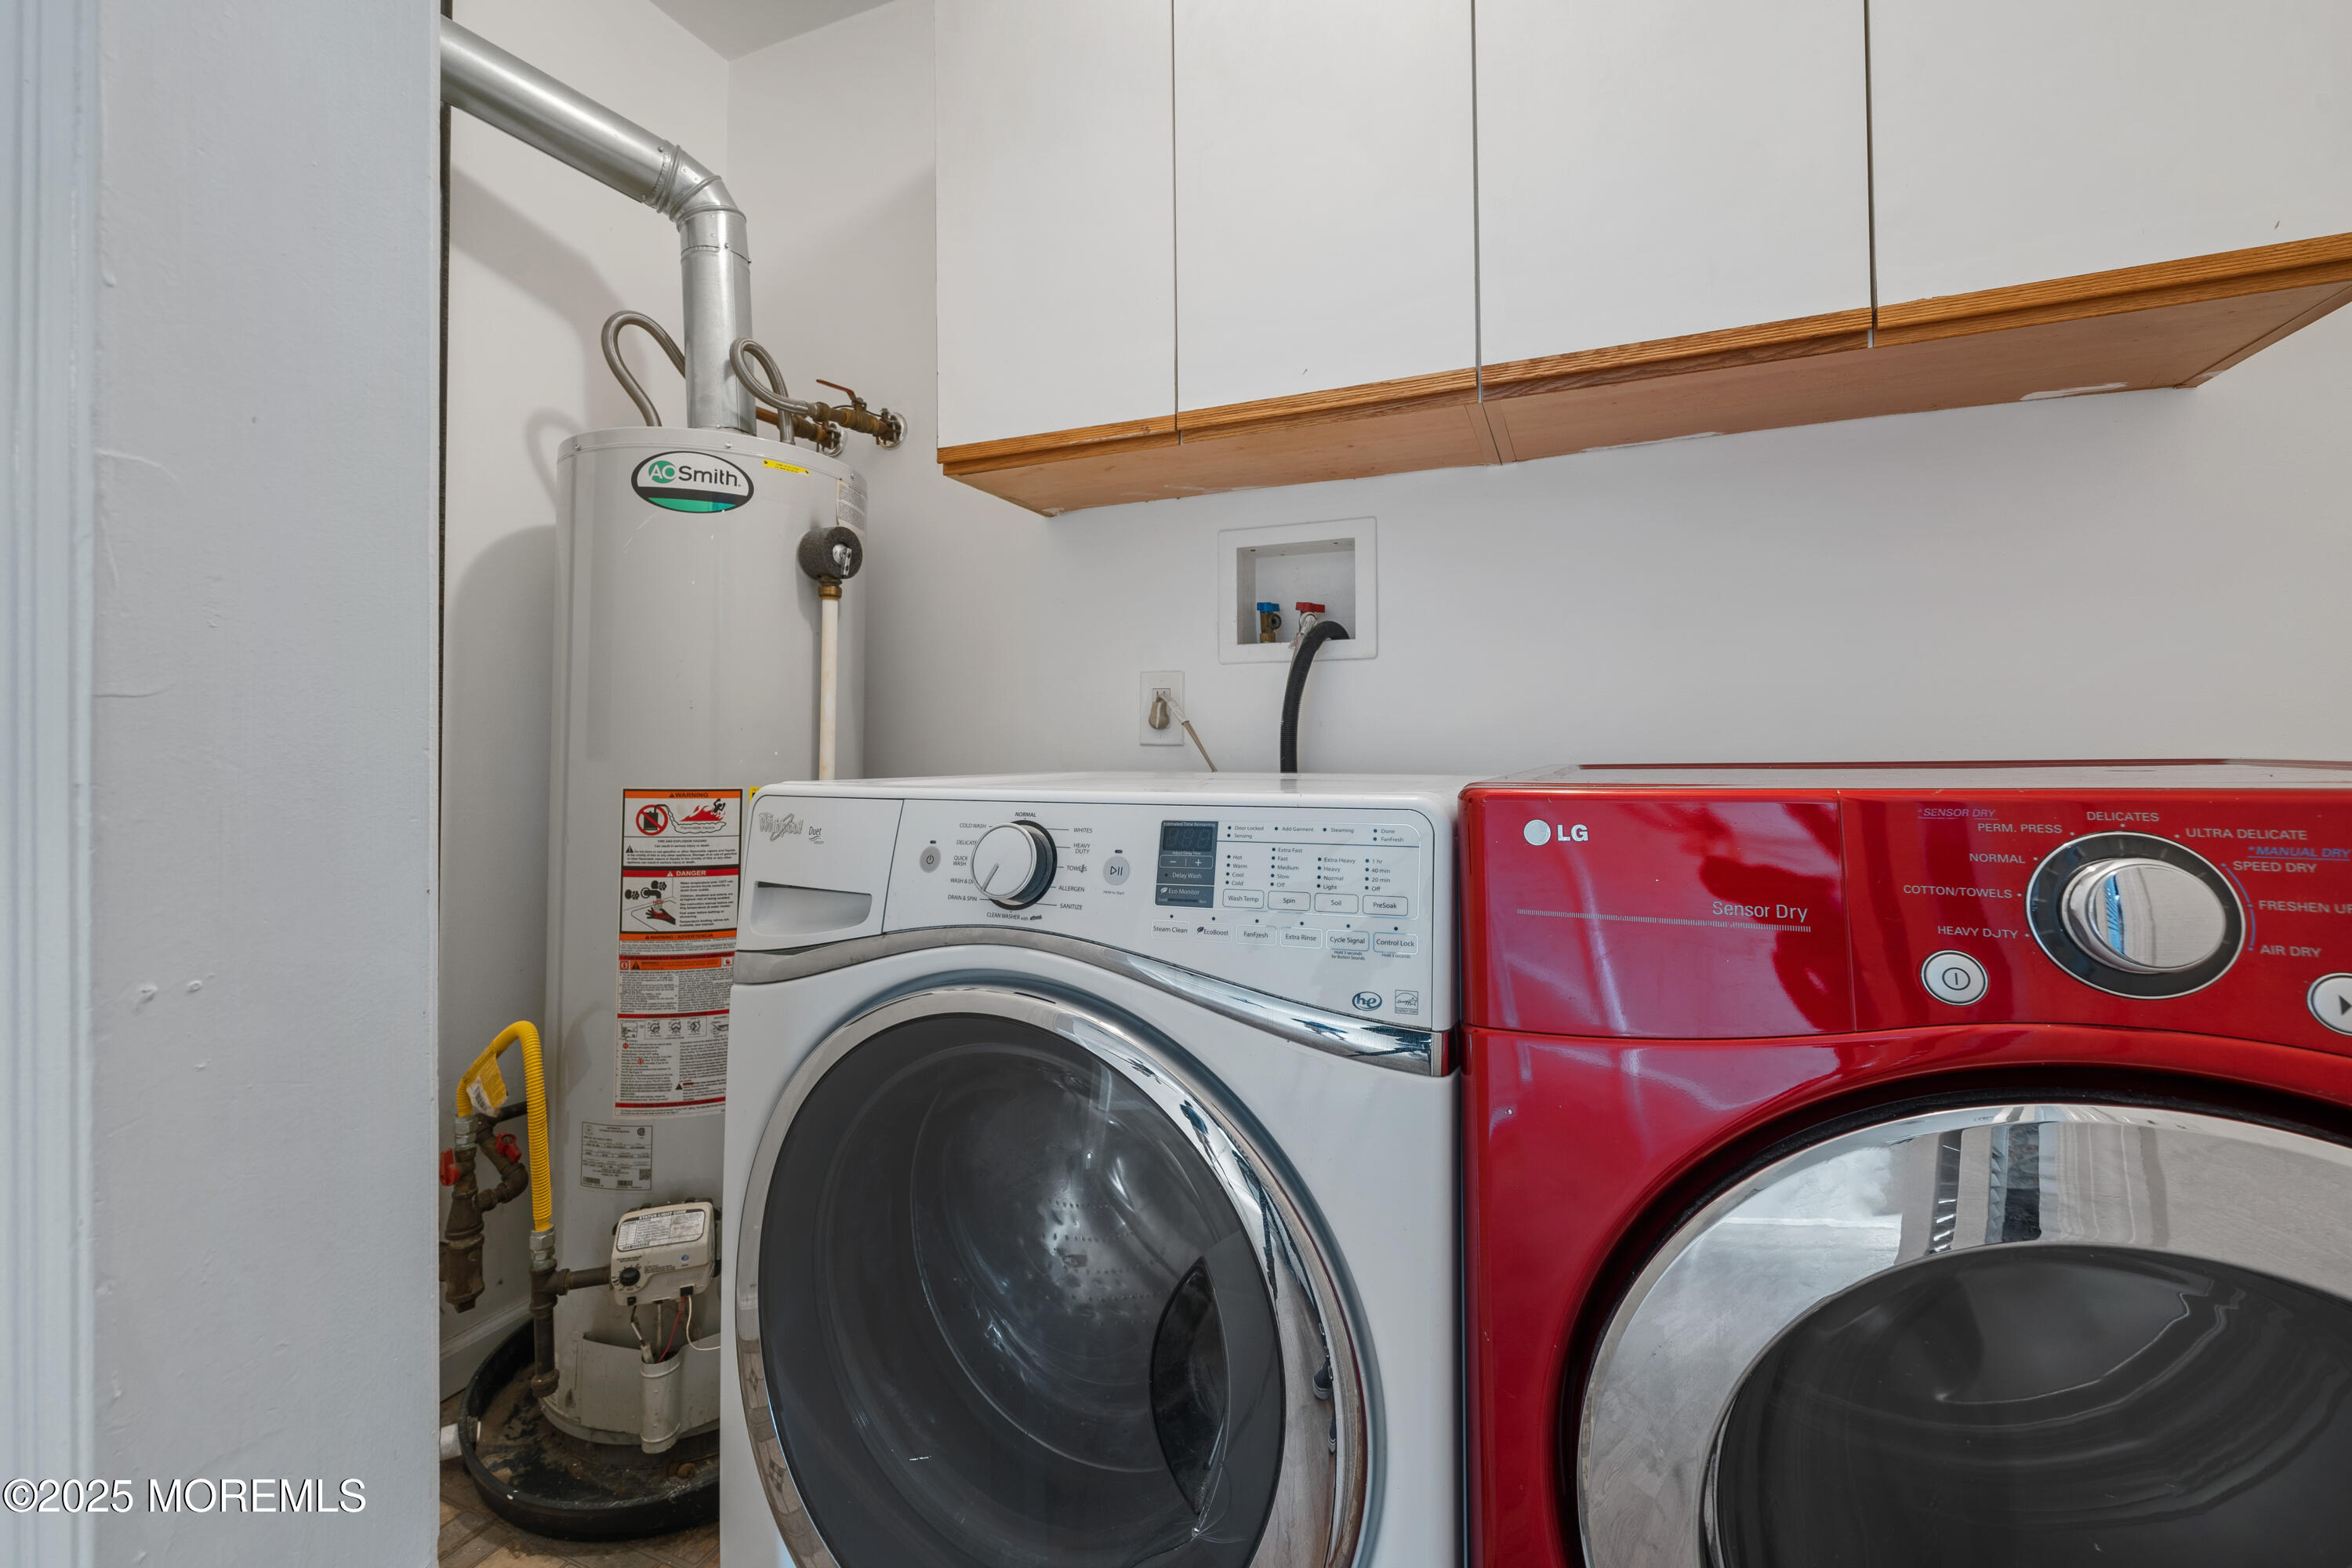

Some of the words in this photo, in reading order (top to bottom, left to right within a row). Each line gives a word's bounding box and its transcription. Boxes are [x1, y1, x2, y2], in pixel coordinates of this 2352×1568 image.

[1924, 808, 1969, 817] SENSOR
[1973, 809, 1996, 818] DRY
[2086, 811, 2160, 822] DELICATES
[808, 826, 822, 836] Duet
[1557, 824, 1589, 842] LG
[1977, 823, 2016, 833] PERM.
[2020, 825, 2063, 834] PRESS
[2186, 828, 2234, 838] ULTRA
[2236, 829, 2308, 840] DELICATE
[1969, 853, 2026, 864] NORMAL
[2255, 847, 2318, 857] MANUAL
[2322, 848, 2351, 858] DRY
[2233, 861, 2282, 872] SPEED
[2285, 862, 2318, 873] DRY
[1903, 884, 2013, 898] COTTON/TOWELS
[1712, 901, 1770, 918] Sensor
[1776, 903, 1808, 923] Dry
[2258, 900, 2330, 913] FRESHEN
[1937, 925, 1979, 936] HEAVY
[2259, 945, 2286, 956] AIR
[2289, 946, 2322, 957] DRY
[1356, 993, 1377, 1008] he
